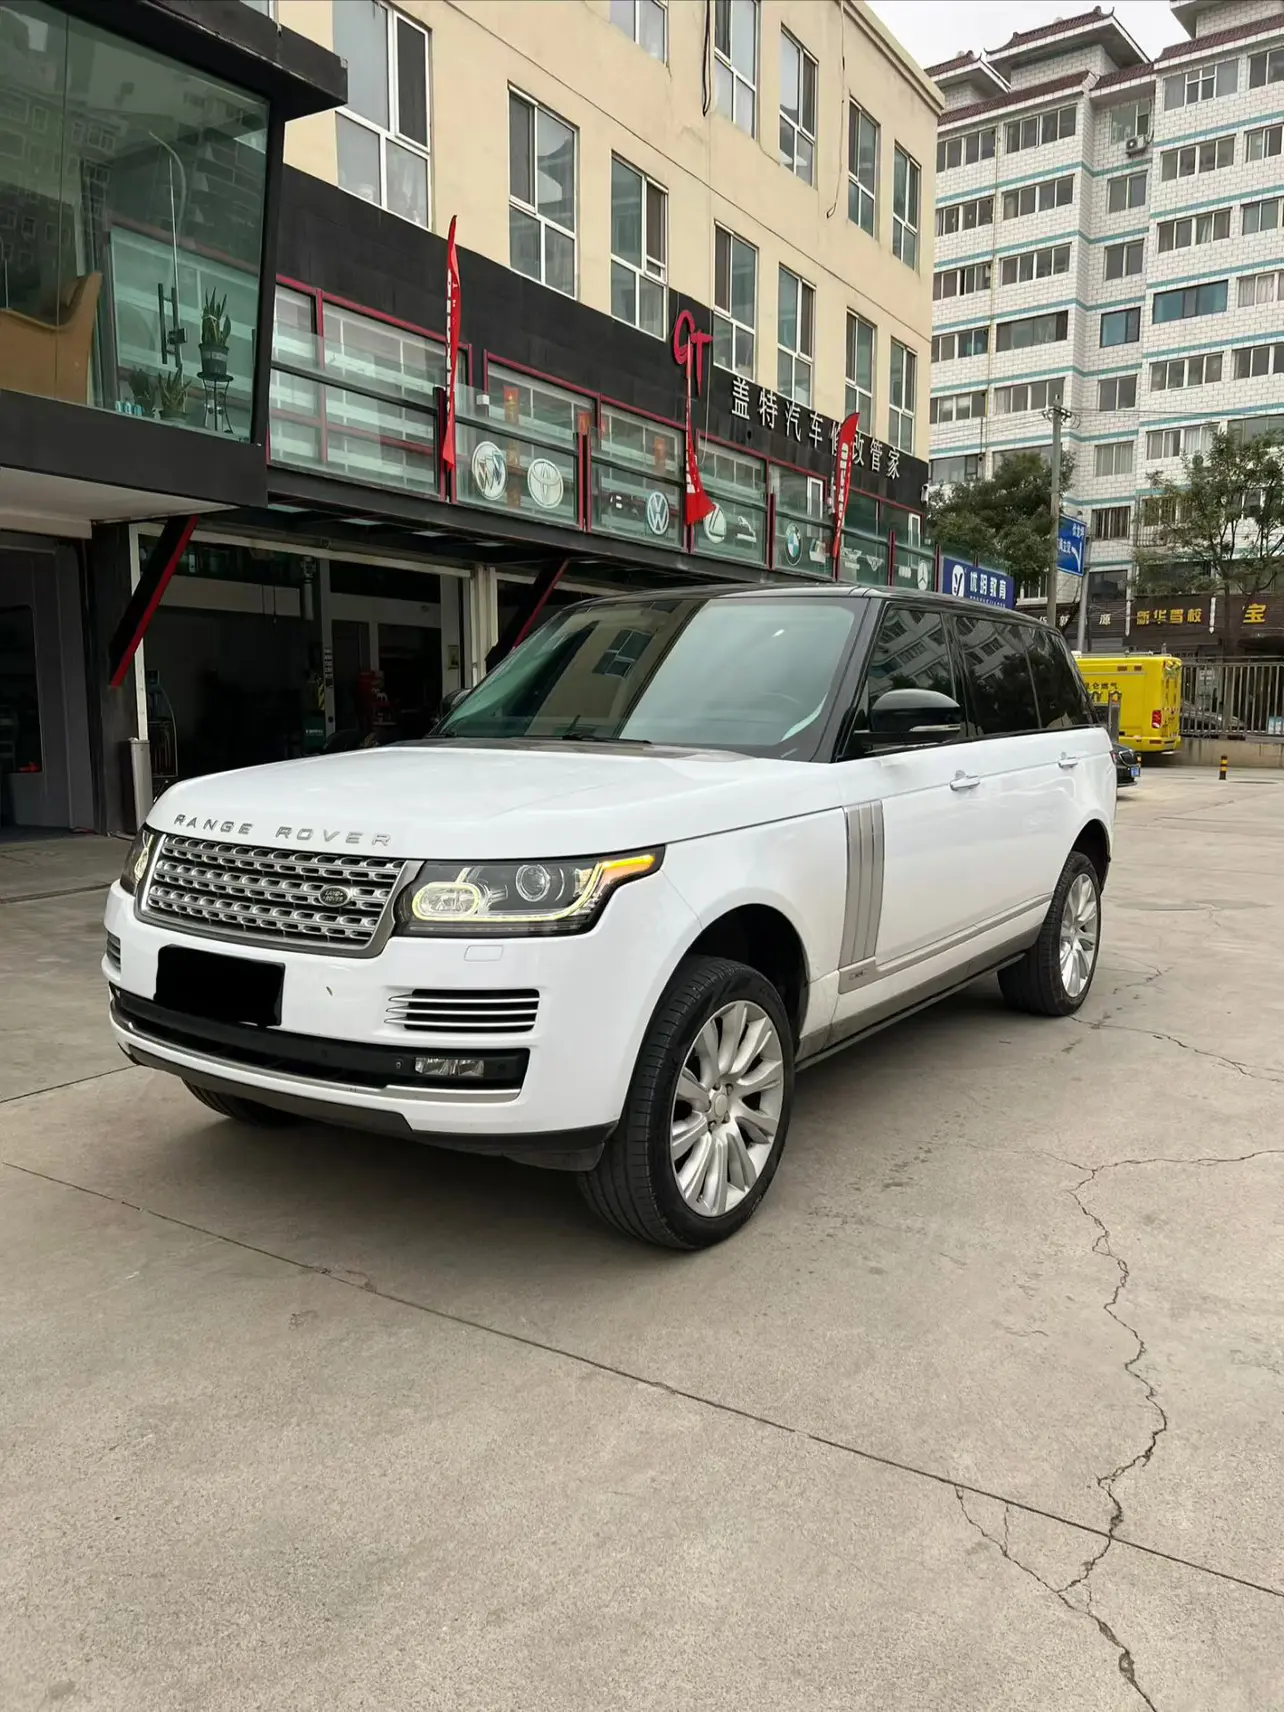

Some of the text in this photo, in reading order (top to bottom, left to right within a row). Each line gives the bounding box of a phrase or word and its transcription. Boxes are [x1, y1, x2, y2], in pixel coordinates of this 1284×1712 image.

[1136, 608, 1202, 625] 新华驾校
[173, 813, 391, 847] RANGE ROVER
